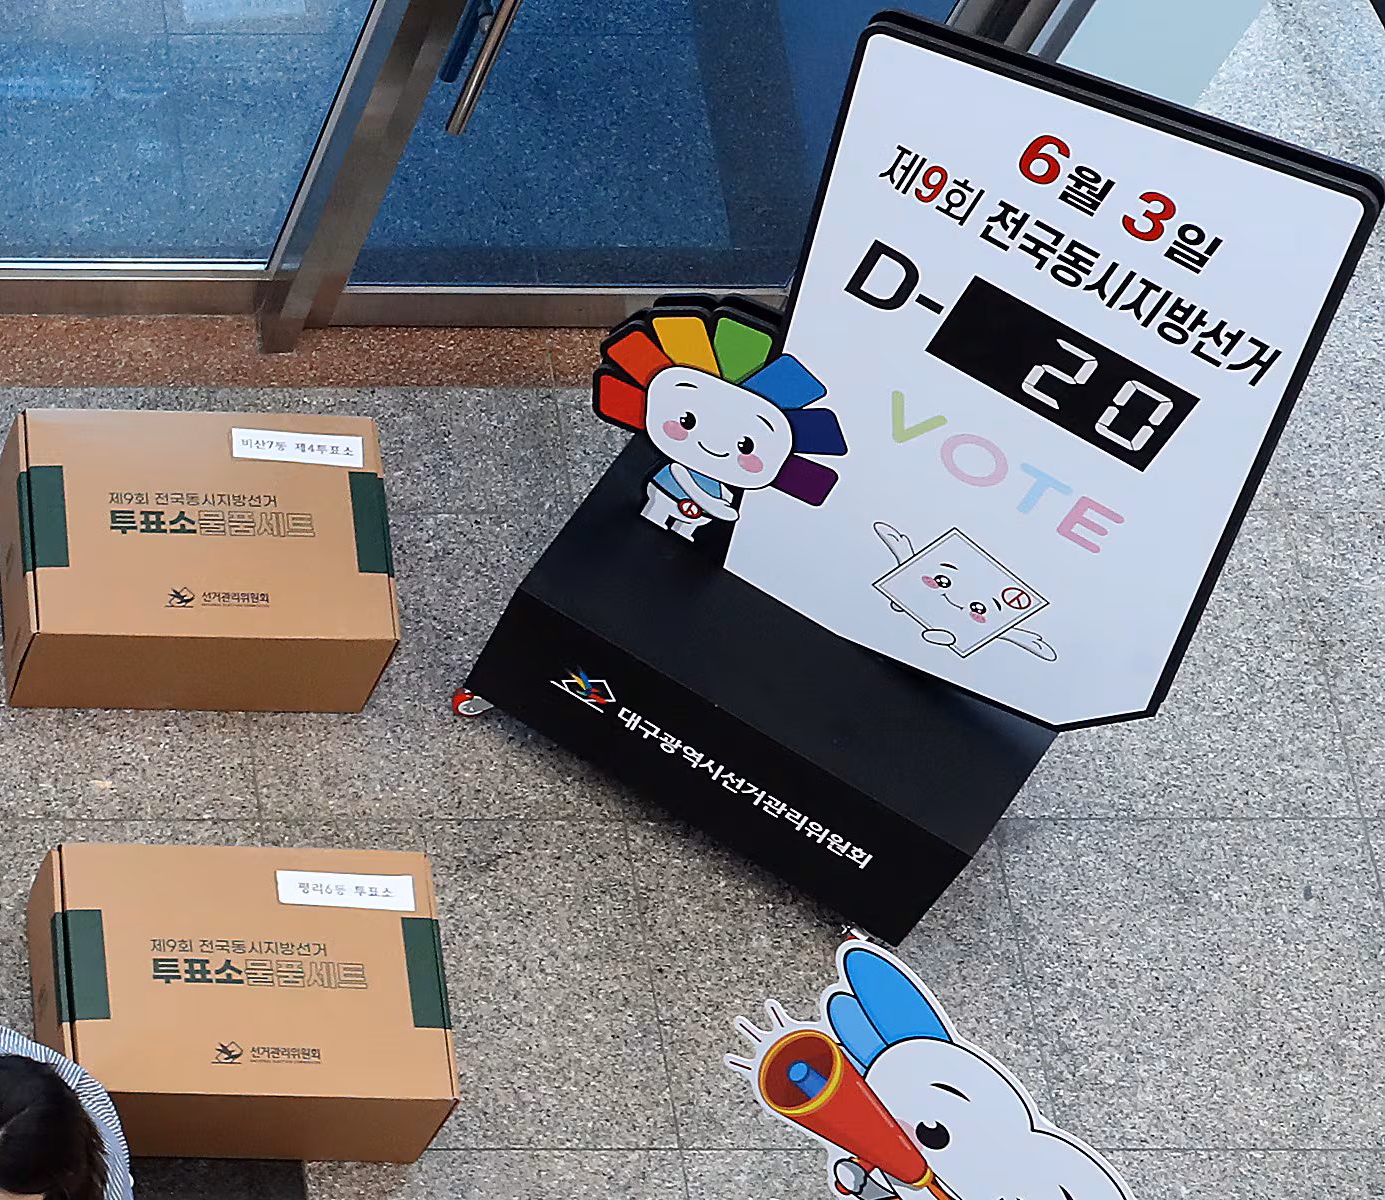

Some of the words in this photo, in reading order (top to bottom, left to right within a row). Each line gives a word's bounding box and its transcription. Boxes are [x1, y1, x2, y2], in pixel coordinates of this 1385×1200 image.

[1017, 133, 1115, 213] 6월
[1120, 190, 1223, 276] 3일
[878, 144, 987, 227] 제9회
[984, 198, 1282, 387] 전국동시지방선거
[1021, 337, 1176, 453] 20
[889, 390, 1125, 554] VOTE
[109, 492, 149, 506] 제9회
[155, 493, 277, 507] 전국동시지방선거
[110, 509, 315, 538] 투표소물품세트
[201, 591, 269, 604] 선거관리위원회
[616, 705, 874, 870] 대구광역시선거관리위원회
[150, 939, 193, 953] 제9회
[199, 940, 328, 956] 전국동시지방선거
[151, 958, 368, 989] 투표소물품세트
[250, 1046, 321, 1060] 선거관리위원회
